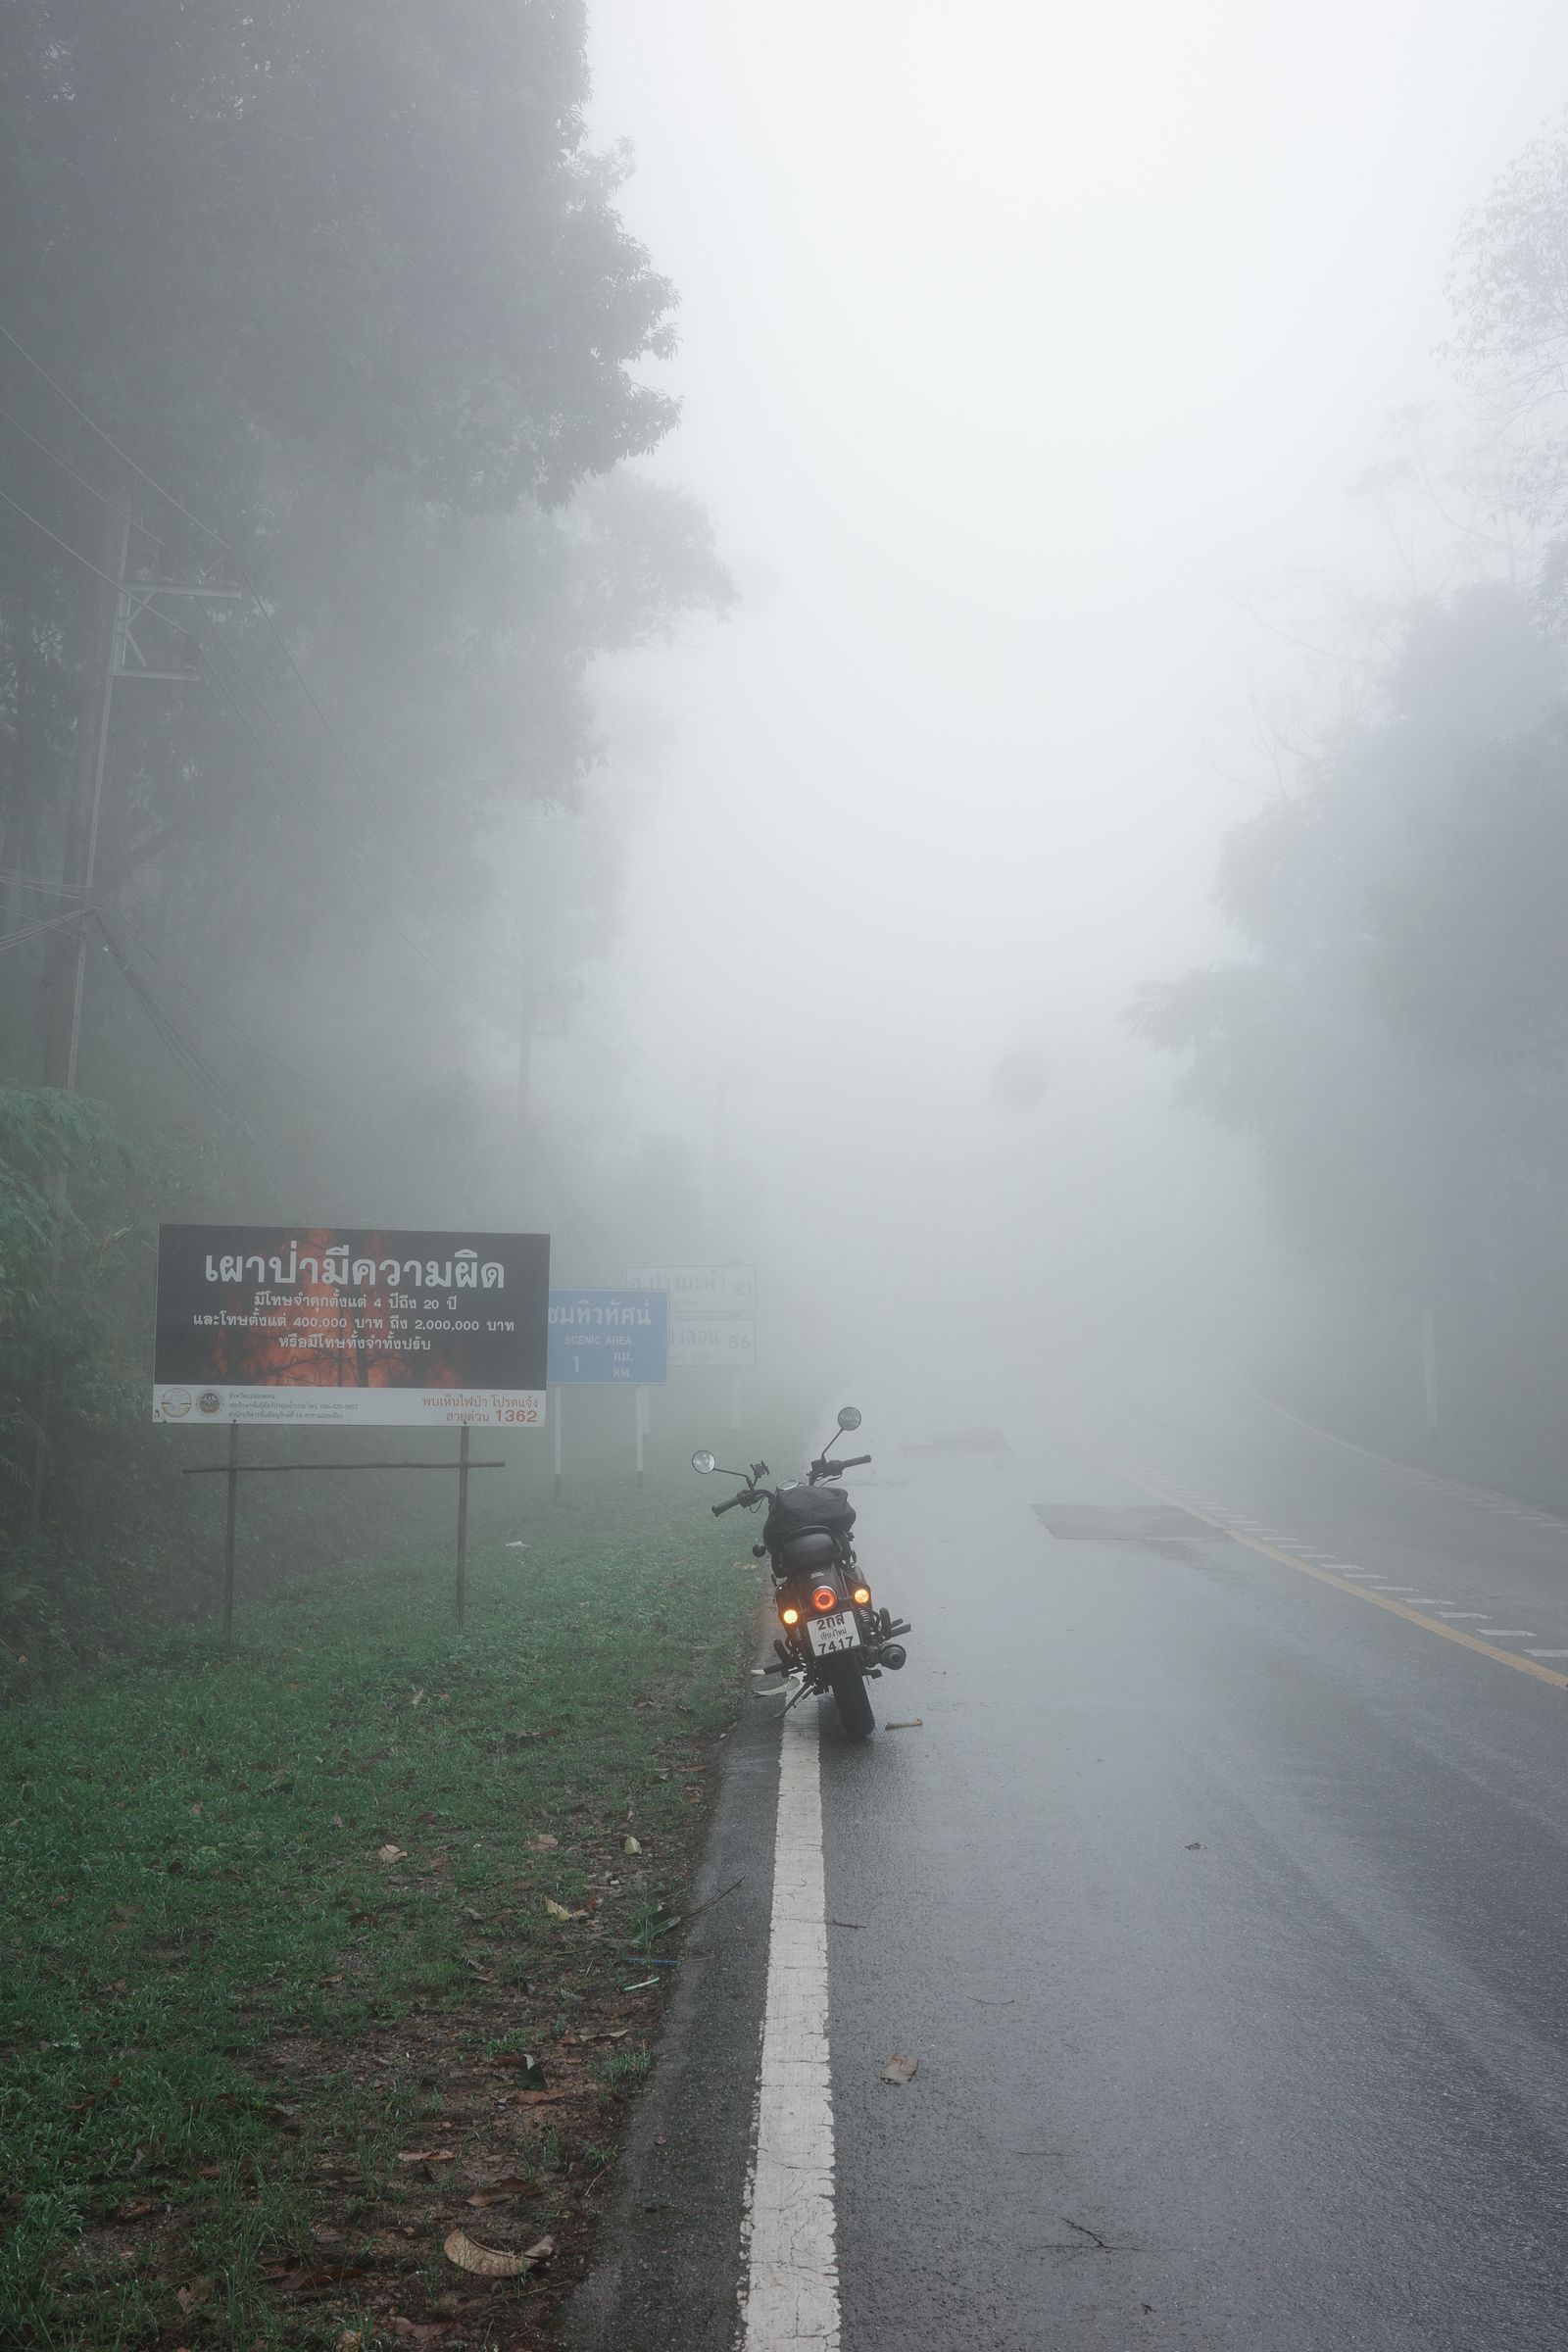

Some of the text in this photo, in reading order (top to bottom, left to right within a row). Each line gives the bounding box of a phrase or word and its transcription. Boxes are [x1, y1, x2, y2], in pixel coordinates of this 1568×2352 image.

[204, 1240, 506, 1289] เผาป่ามีความผิด
[734, 1280, 753, 1297] 21
[253, 1290, 458, 1312] มีโทษจำคุกตั้งแต่ 4 ปีถึง 20 ปี
[192, 1308, 287, 1327] และโทษตั้งแต่
[354, 1317, 383, 1329] บาท
[389, 1313, 409, 1331] ถึง
[414, 1319, 480, 1332] 2,000,000
[486, 1319, 515, 1332] บาท
[278, 1332, 432, 1351] หรือมีโทษทั้งจำทั้งปรับ
[564, 1335, 632, 1346] SCENIC AREA
[728, 1335, 752, 1350] 86
[573, 1351, 634, 1373] 1 กม.
[613, 1367, 632, 1379] KM.
[422, 1394, 538, 1409] พบเห็นไฟป่า โปรดแจ้ง
[446, 1409, 538, 1423] สายด่วน 1362
[818, 1637, 854, 1654] 7417
